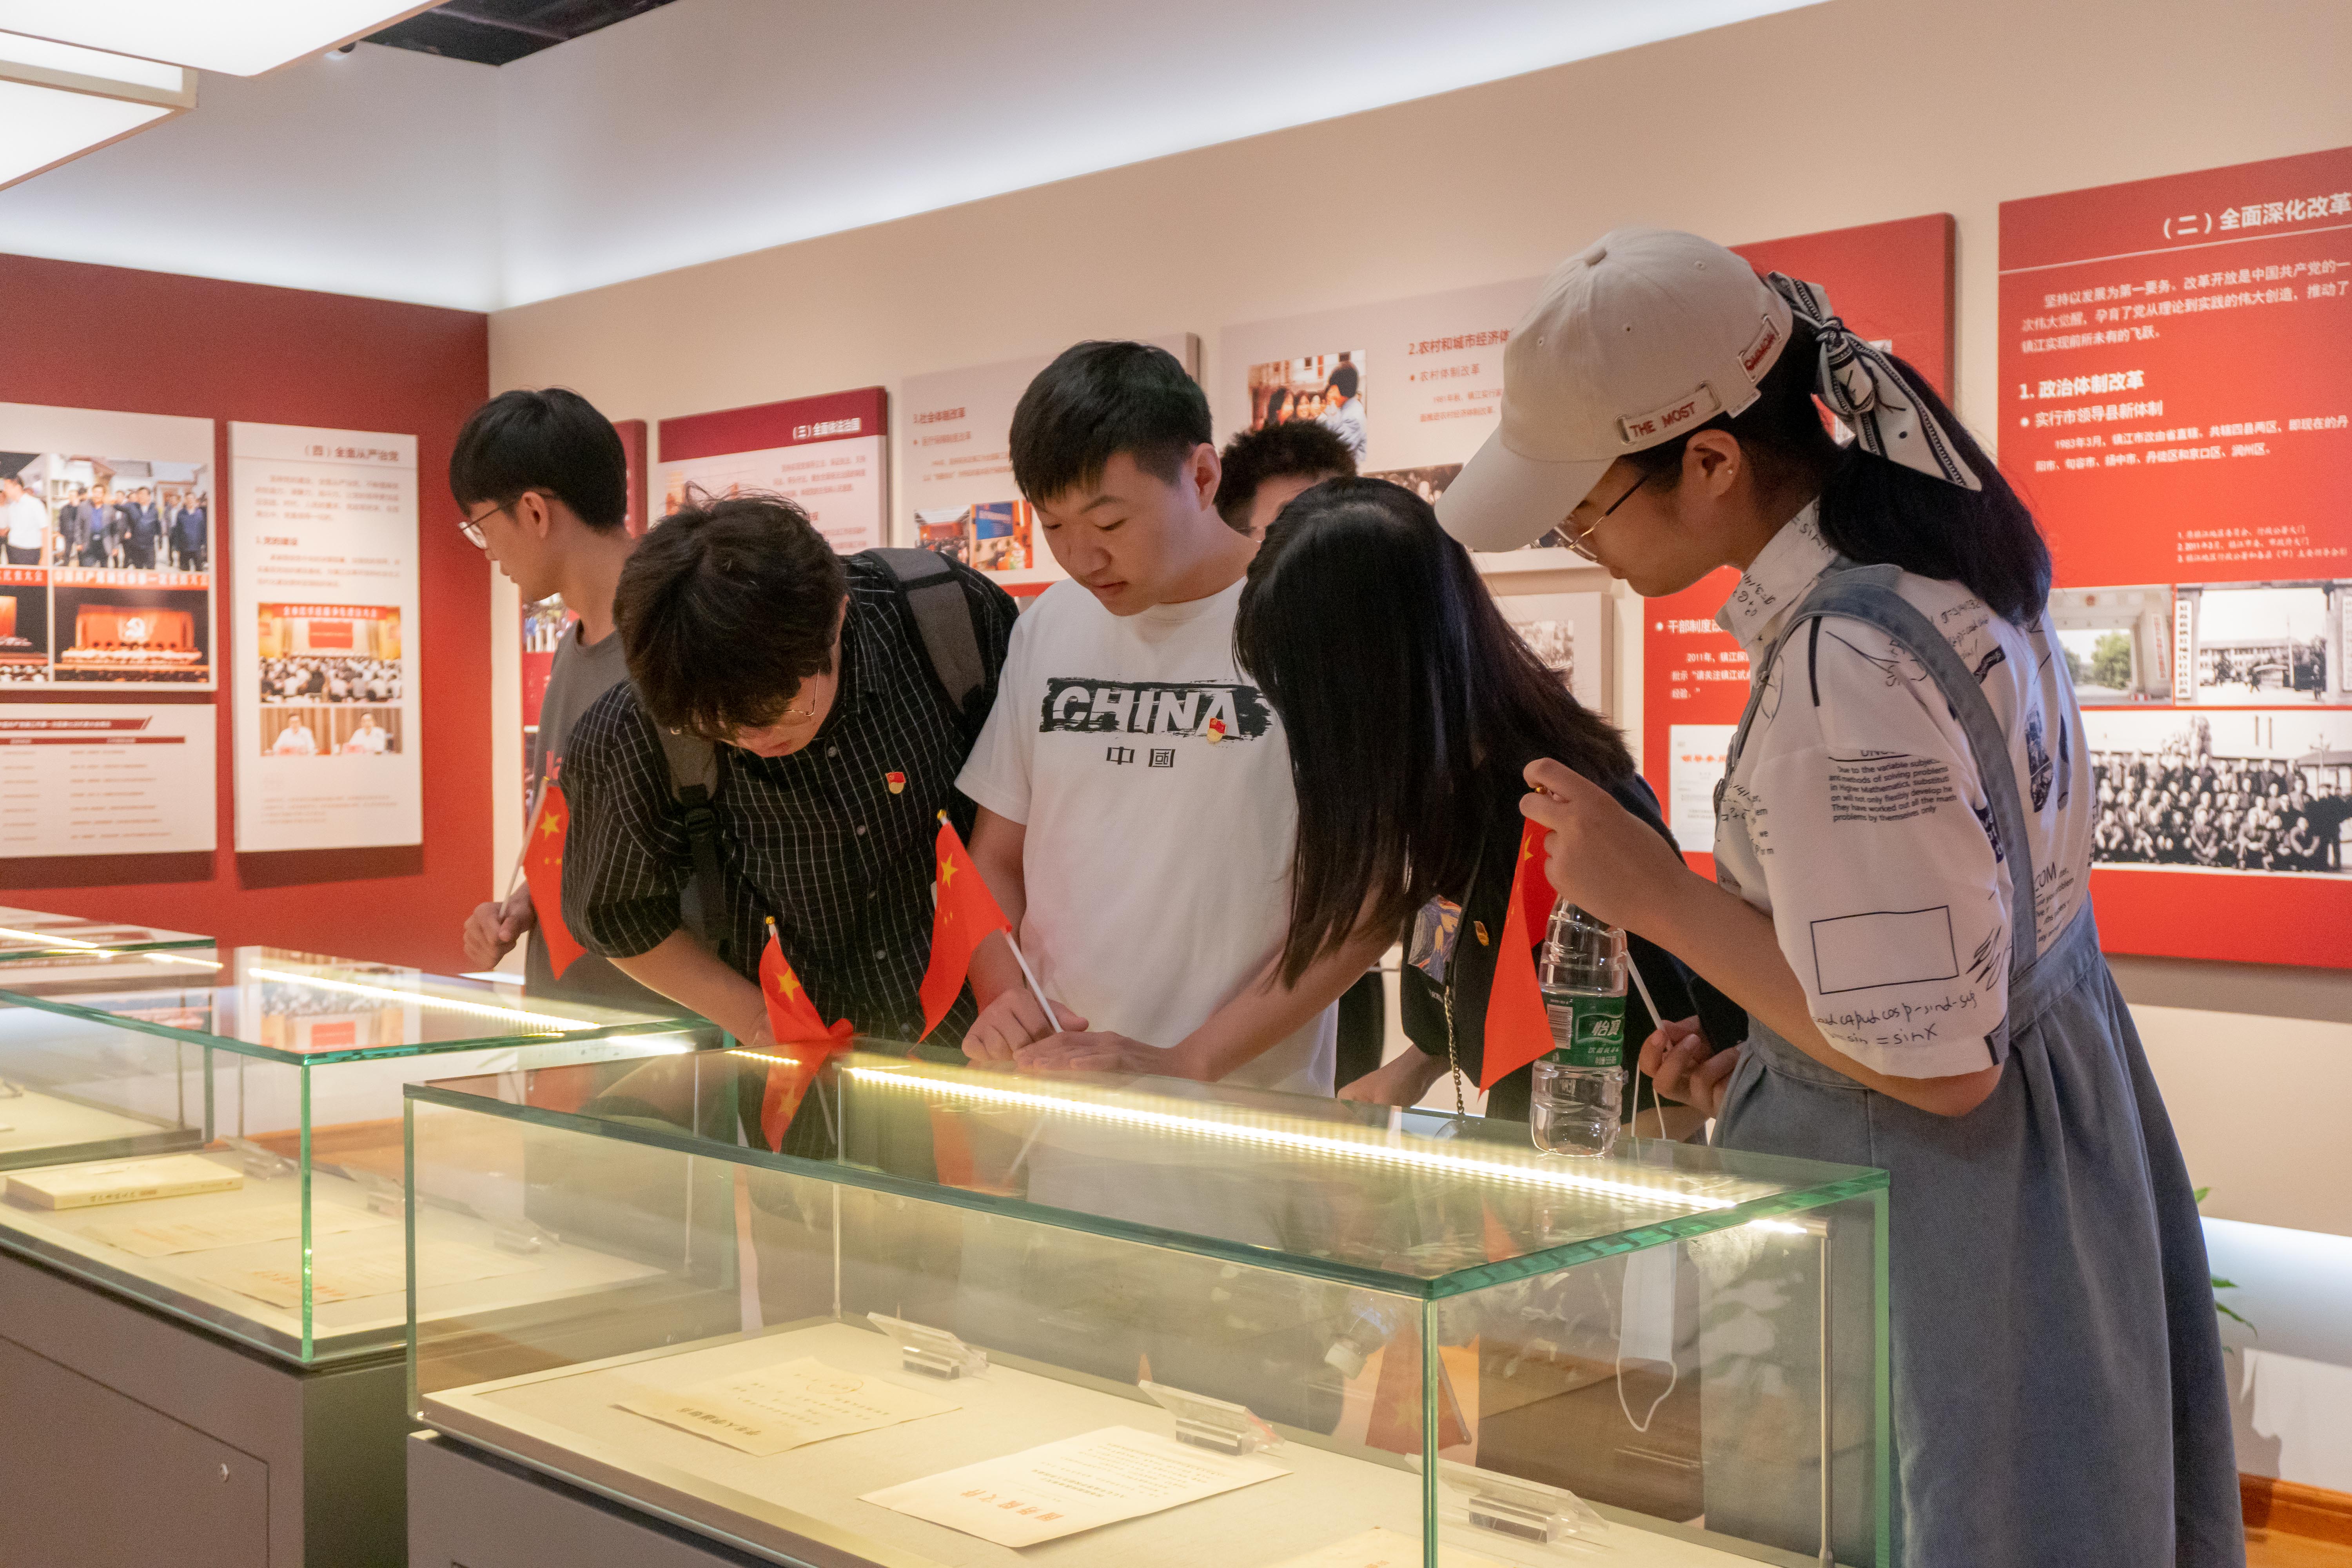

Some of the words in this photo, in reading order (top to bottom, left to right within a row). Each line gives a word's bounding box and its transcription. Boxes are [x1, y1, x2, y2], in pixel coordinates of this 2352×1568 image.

[1629, 420, 1656, 438] THE
[1661, 401, 1695, 428] MOST
[2034, 399, 2163, 428] 实行市领导县新体制
[1051, 686, 1240, 737] CHINA
[1884, 772, 1911, 781] solving
[1913, 766, 1949, 777] problems
[1911, 788, 1942, 797] develop
[1831, 804, 1850, 813] They
[1911, 798, 1919, 807] all
[1868, 815, 1877, 823] by
[1921, 805, 1936, 814] only
